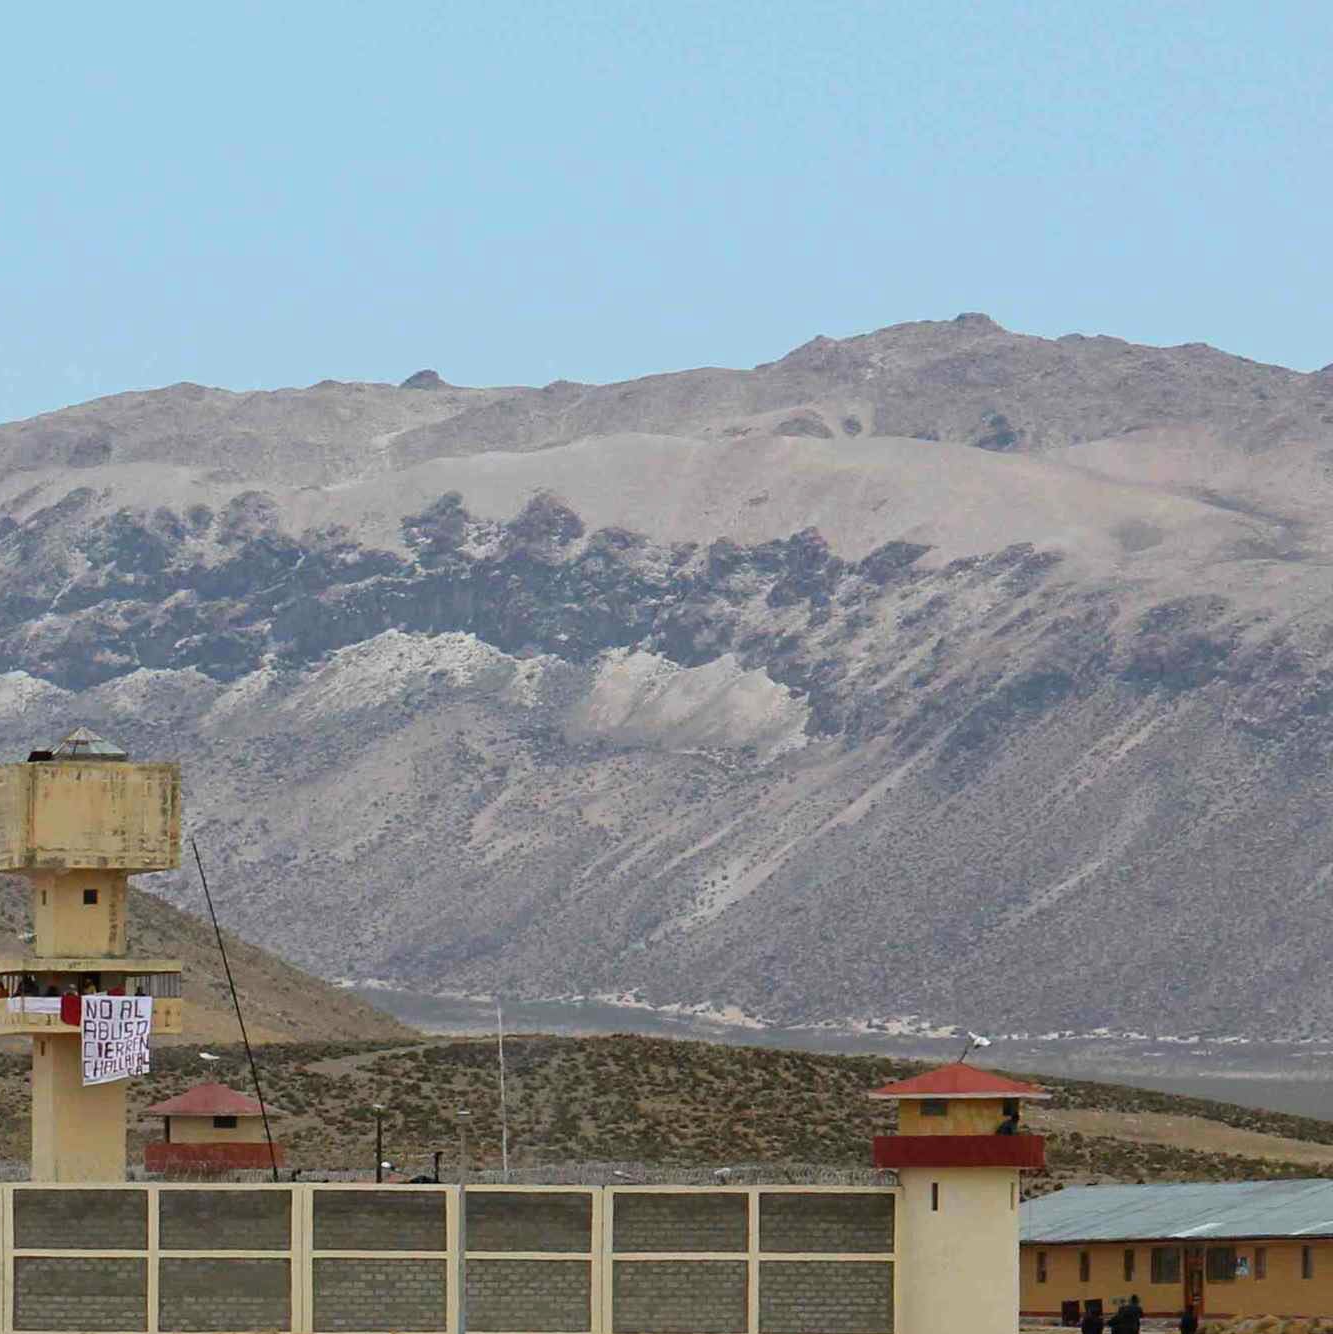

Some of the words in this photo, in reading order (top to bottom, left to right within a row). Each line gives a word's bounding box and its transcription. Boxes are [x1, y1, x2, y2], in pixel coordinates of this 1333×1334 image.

[86, 1000, 112, 1019] NO
[120, 1000, 144, 1019] AL
[84, 1020, 148, 1040] ABUSO
[84, 1034, 149, 1059] CIERREN
